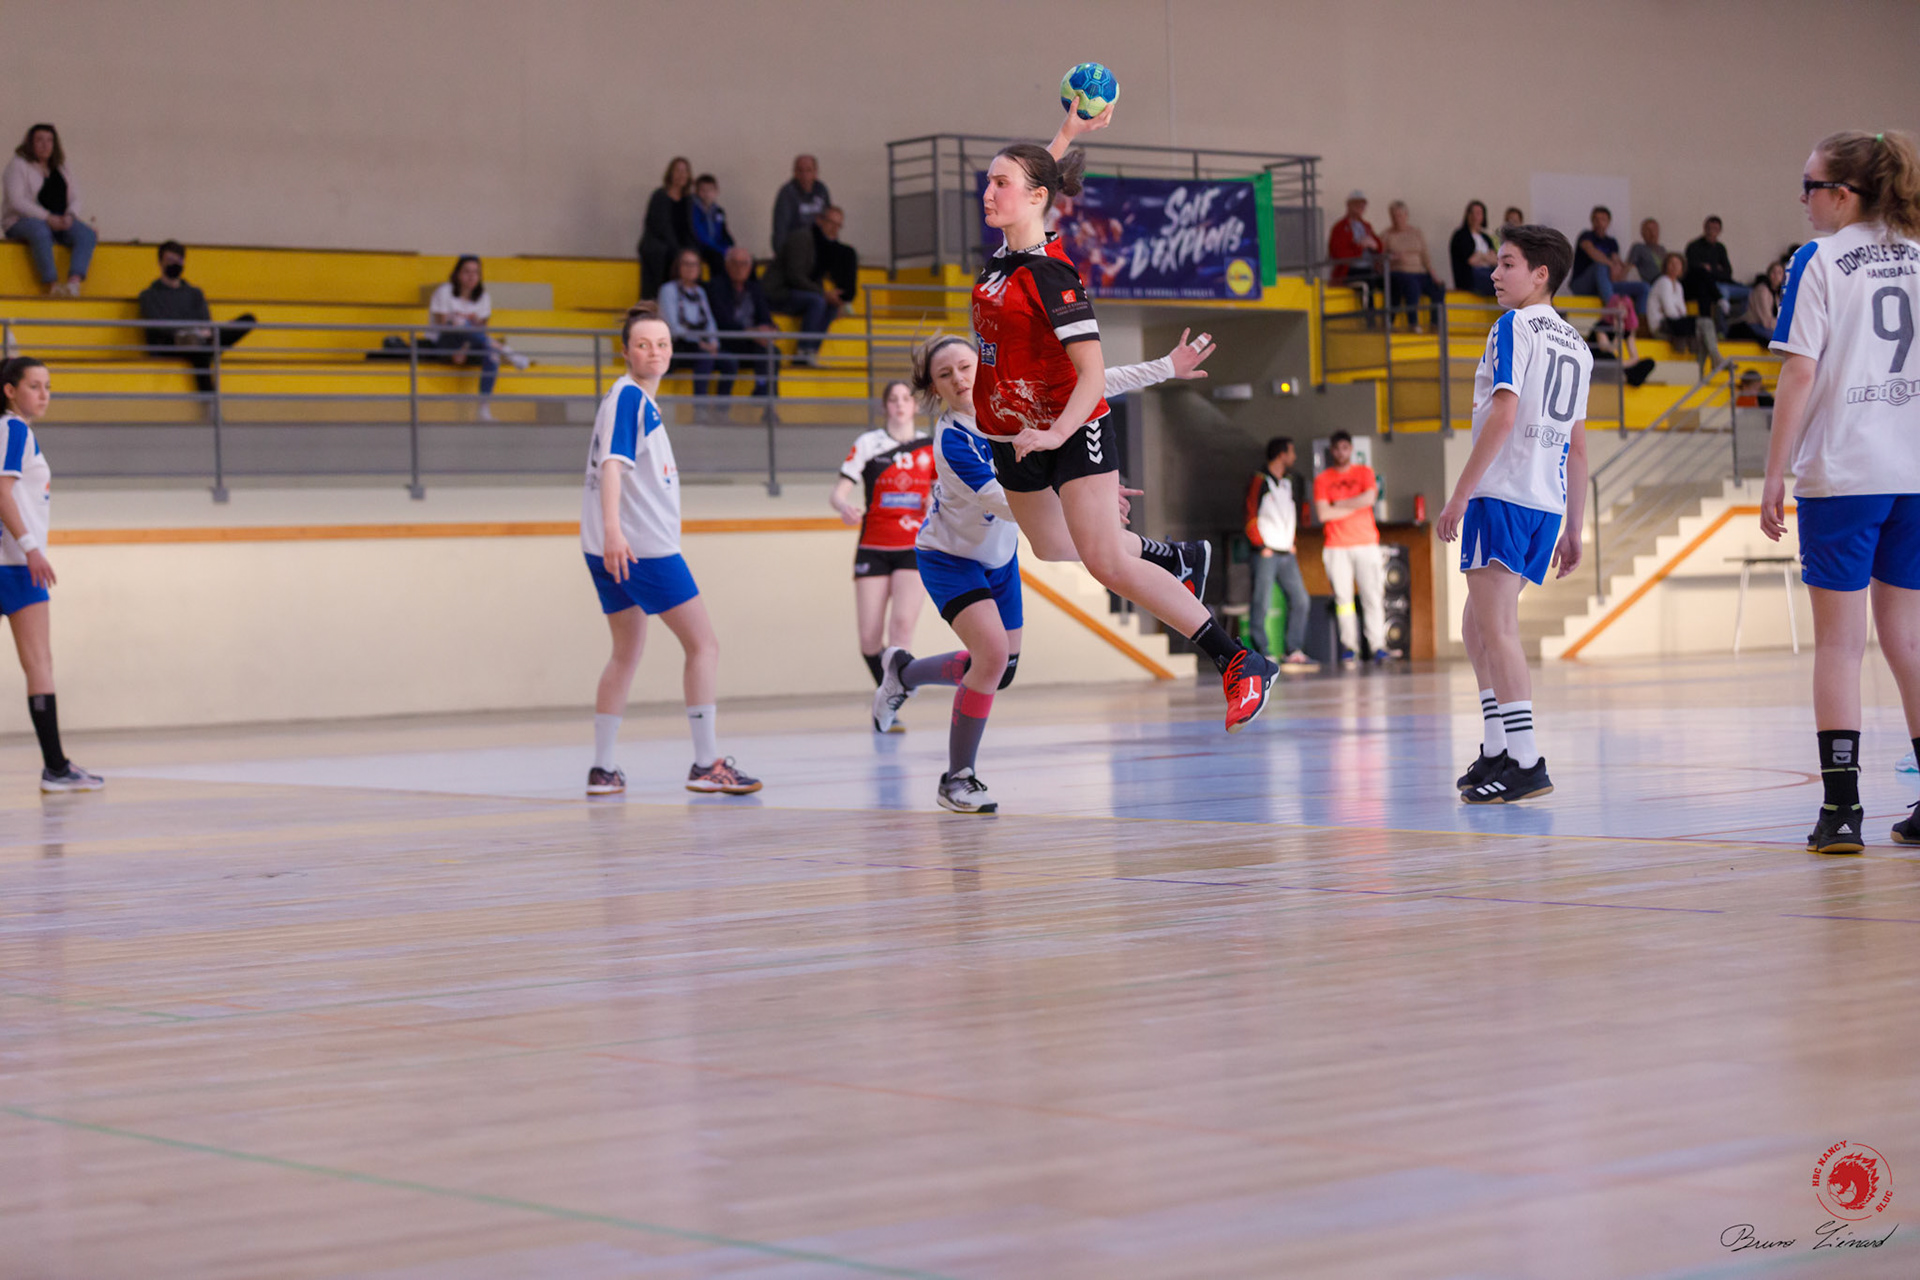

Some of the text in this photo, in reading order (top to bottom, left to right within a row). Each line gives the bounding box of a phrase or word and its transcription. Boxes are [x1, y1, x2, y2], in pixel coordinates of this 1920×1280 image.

[1866, 264, 1917, 279] HANDBALL
[1871, 286, 1914, 374] 9
[1546, 333, 1578, 351] HANDBALL
[1541, 347, 1581, 422] 10
[892, 451, 914, 470] 13
